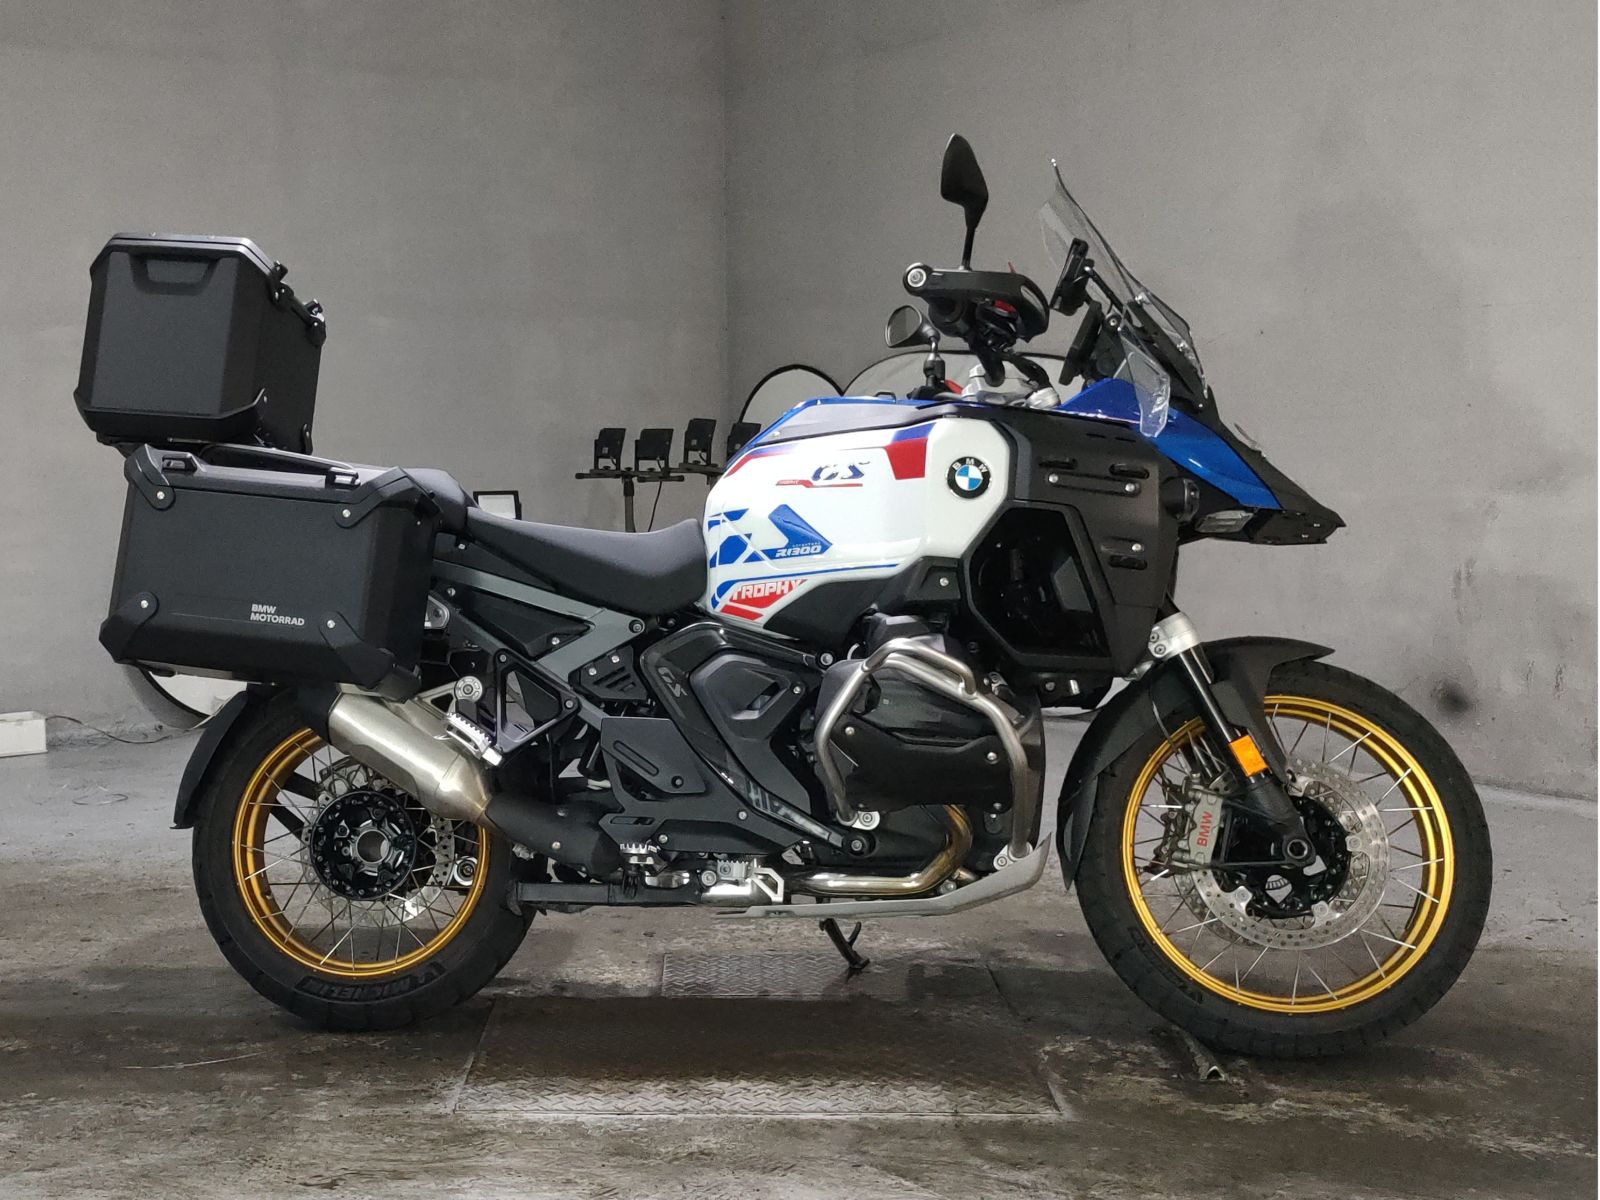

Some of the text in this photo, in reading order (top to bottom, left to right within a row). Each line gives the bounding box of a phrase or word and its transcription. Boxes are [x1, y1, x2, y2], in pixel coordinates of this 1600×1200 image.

[811, 461, 869, 481] GS
[952, 457, 988, 472] BMW
[775, 545, 821, 557] R1300
[732, 579, 801, 600] TROPHY
[251, 603, 277, 613] BMW
[250, 612, 305, 626] MOTORRAD
[1197, 812, 1212, 847] BMW
